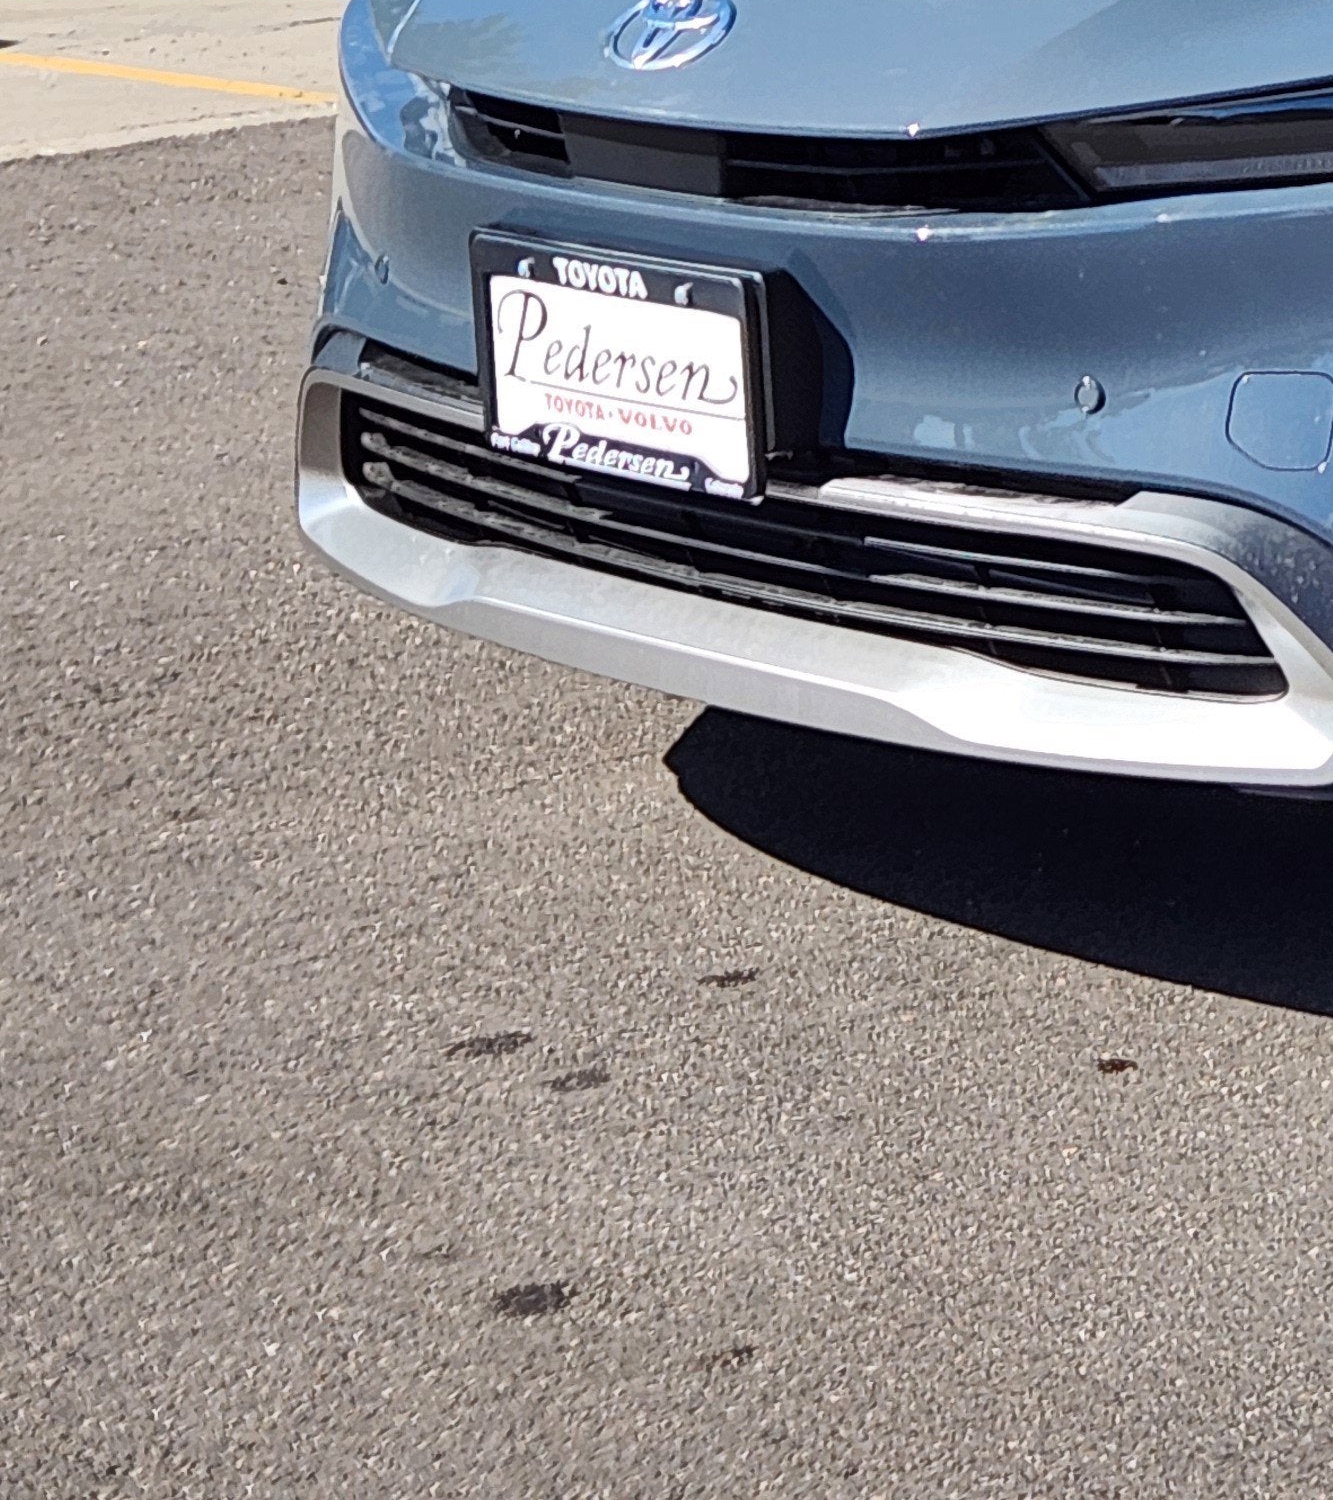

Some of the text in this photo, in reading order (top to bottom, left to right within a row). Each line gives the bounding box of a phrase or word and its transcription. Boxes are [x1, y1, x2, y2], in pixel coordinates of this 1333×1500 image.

[552, 256, 648, 299] TOYOTA
[497, 288, 738, 405] Pedersen
[544, 392, 694, 436] TOYOTA VOLVO
[542, 422, 691, 483] Pedersen
